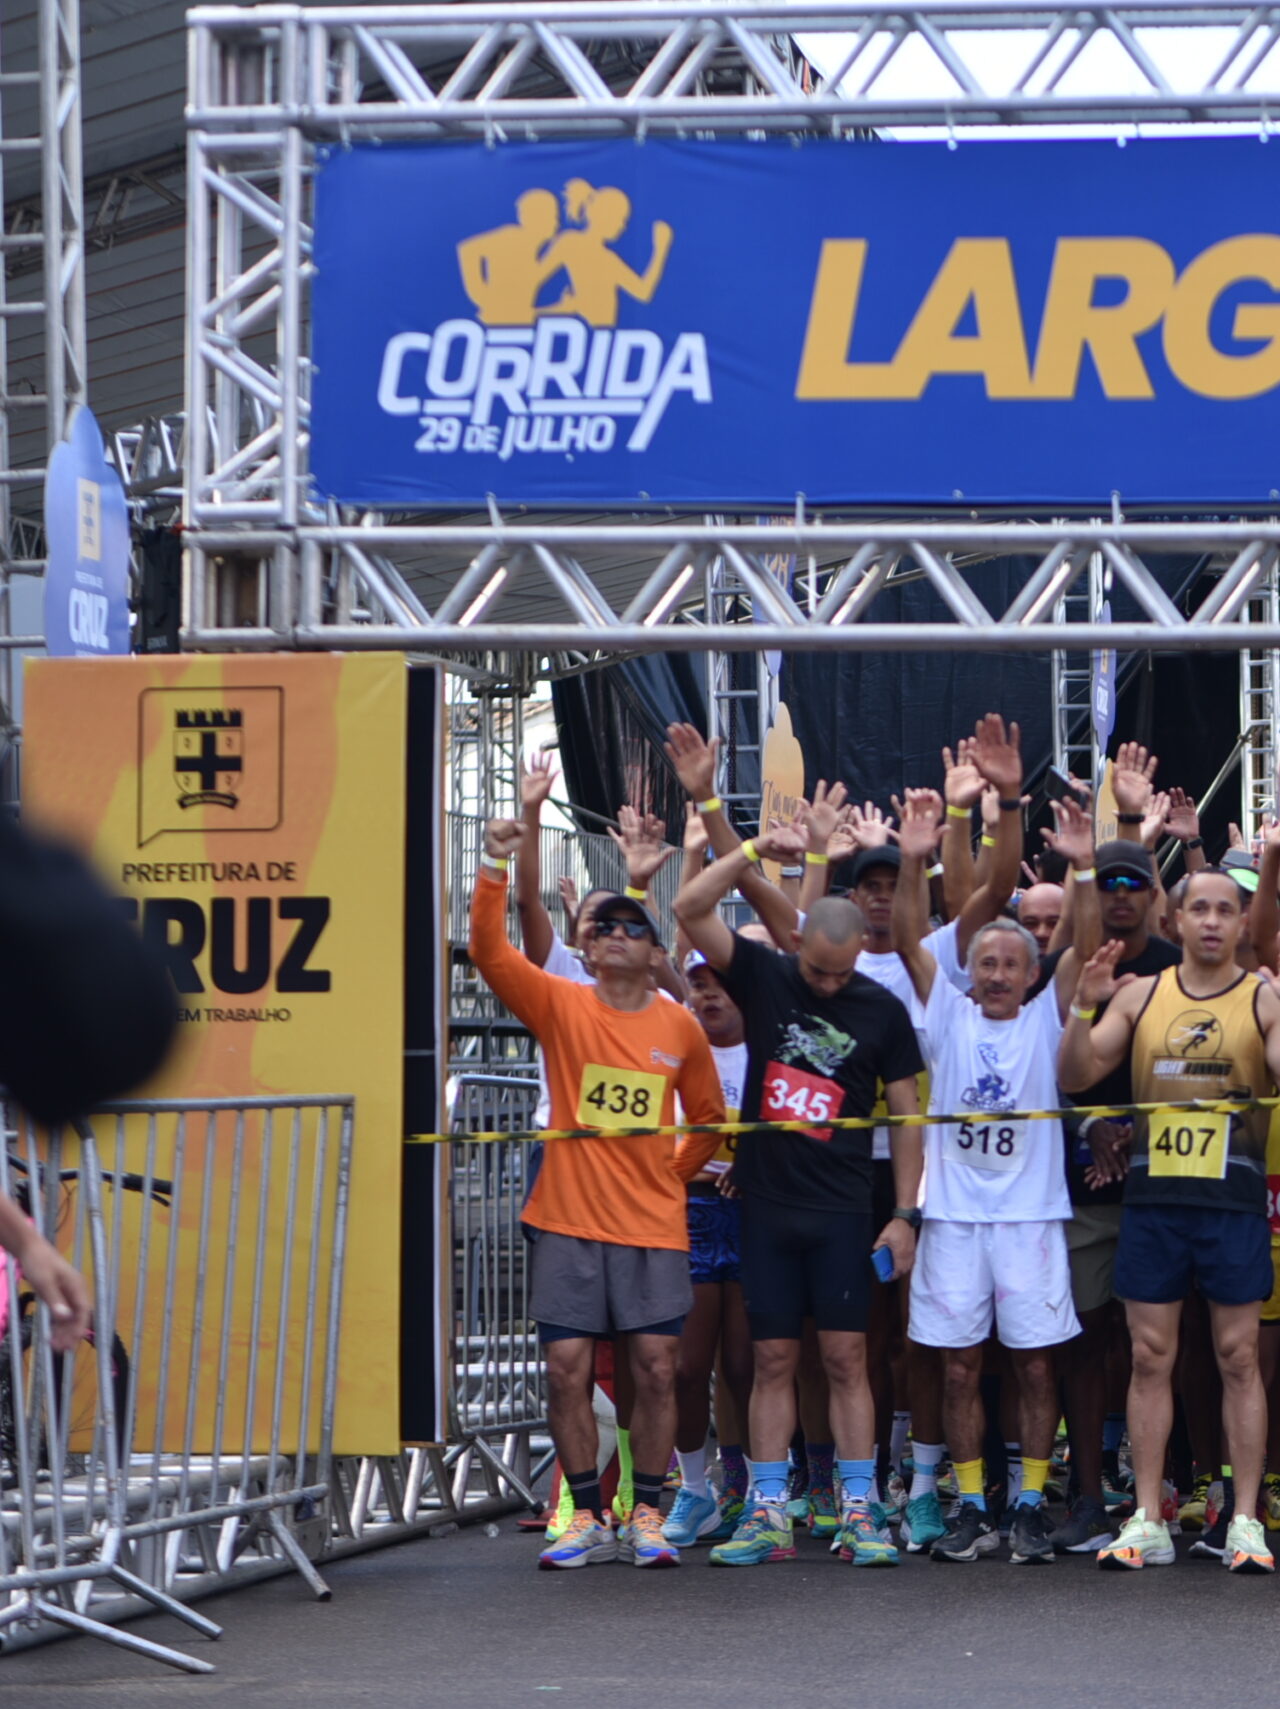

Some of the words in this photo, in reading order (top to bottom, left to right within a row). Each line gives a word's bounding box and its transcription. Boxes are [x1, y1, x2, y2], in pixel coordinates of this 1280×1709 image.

[377, 315, 712, 452] CORRIDA
[413, 415, 463, 453] 29
[462, 425, 501, 453] DE
[498, 415, 618, 461] JULHO
[121, 861, 262, 884] PREFEITURA
[267, 861, 297, 882] DE
[118, 896, 332, 994] RUZ
[177, 1008, 200, 1022] EM
[206, 1007, 292, 1023] TRABALHO
[585, 1080, 651, 1118] 438
[767, 1078, 833, 1122] 345
[957, 1121, 1015, 1157] 518
[1155, 1126, 1218, 1158] 407
